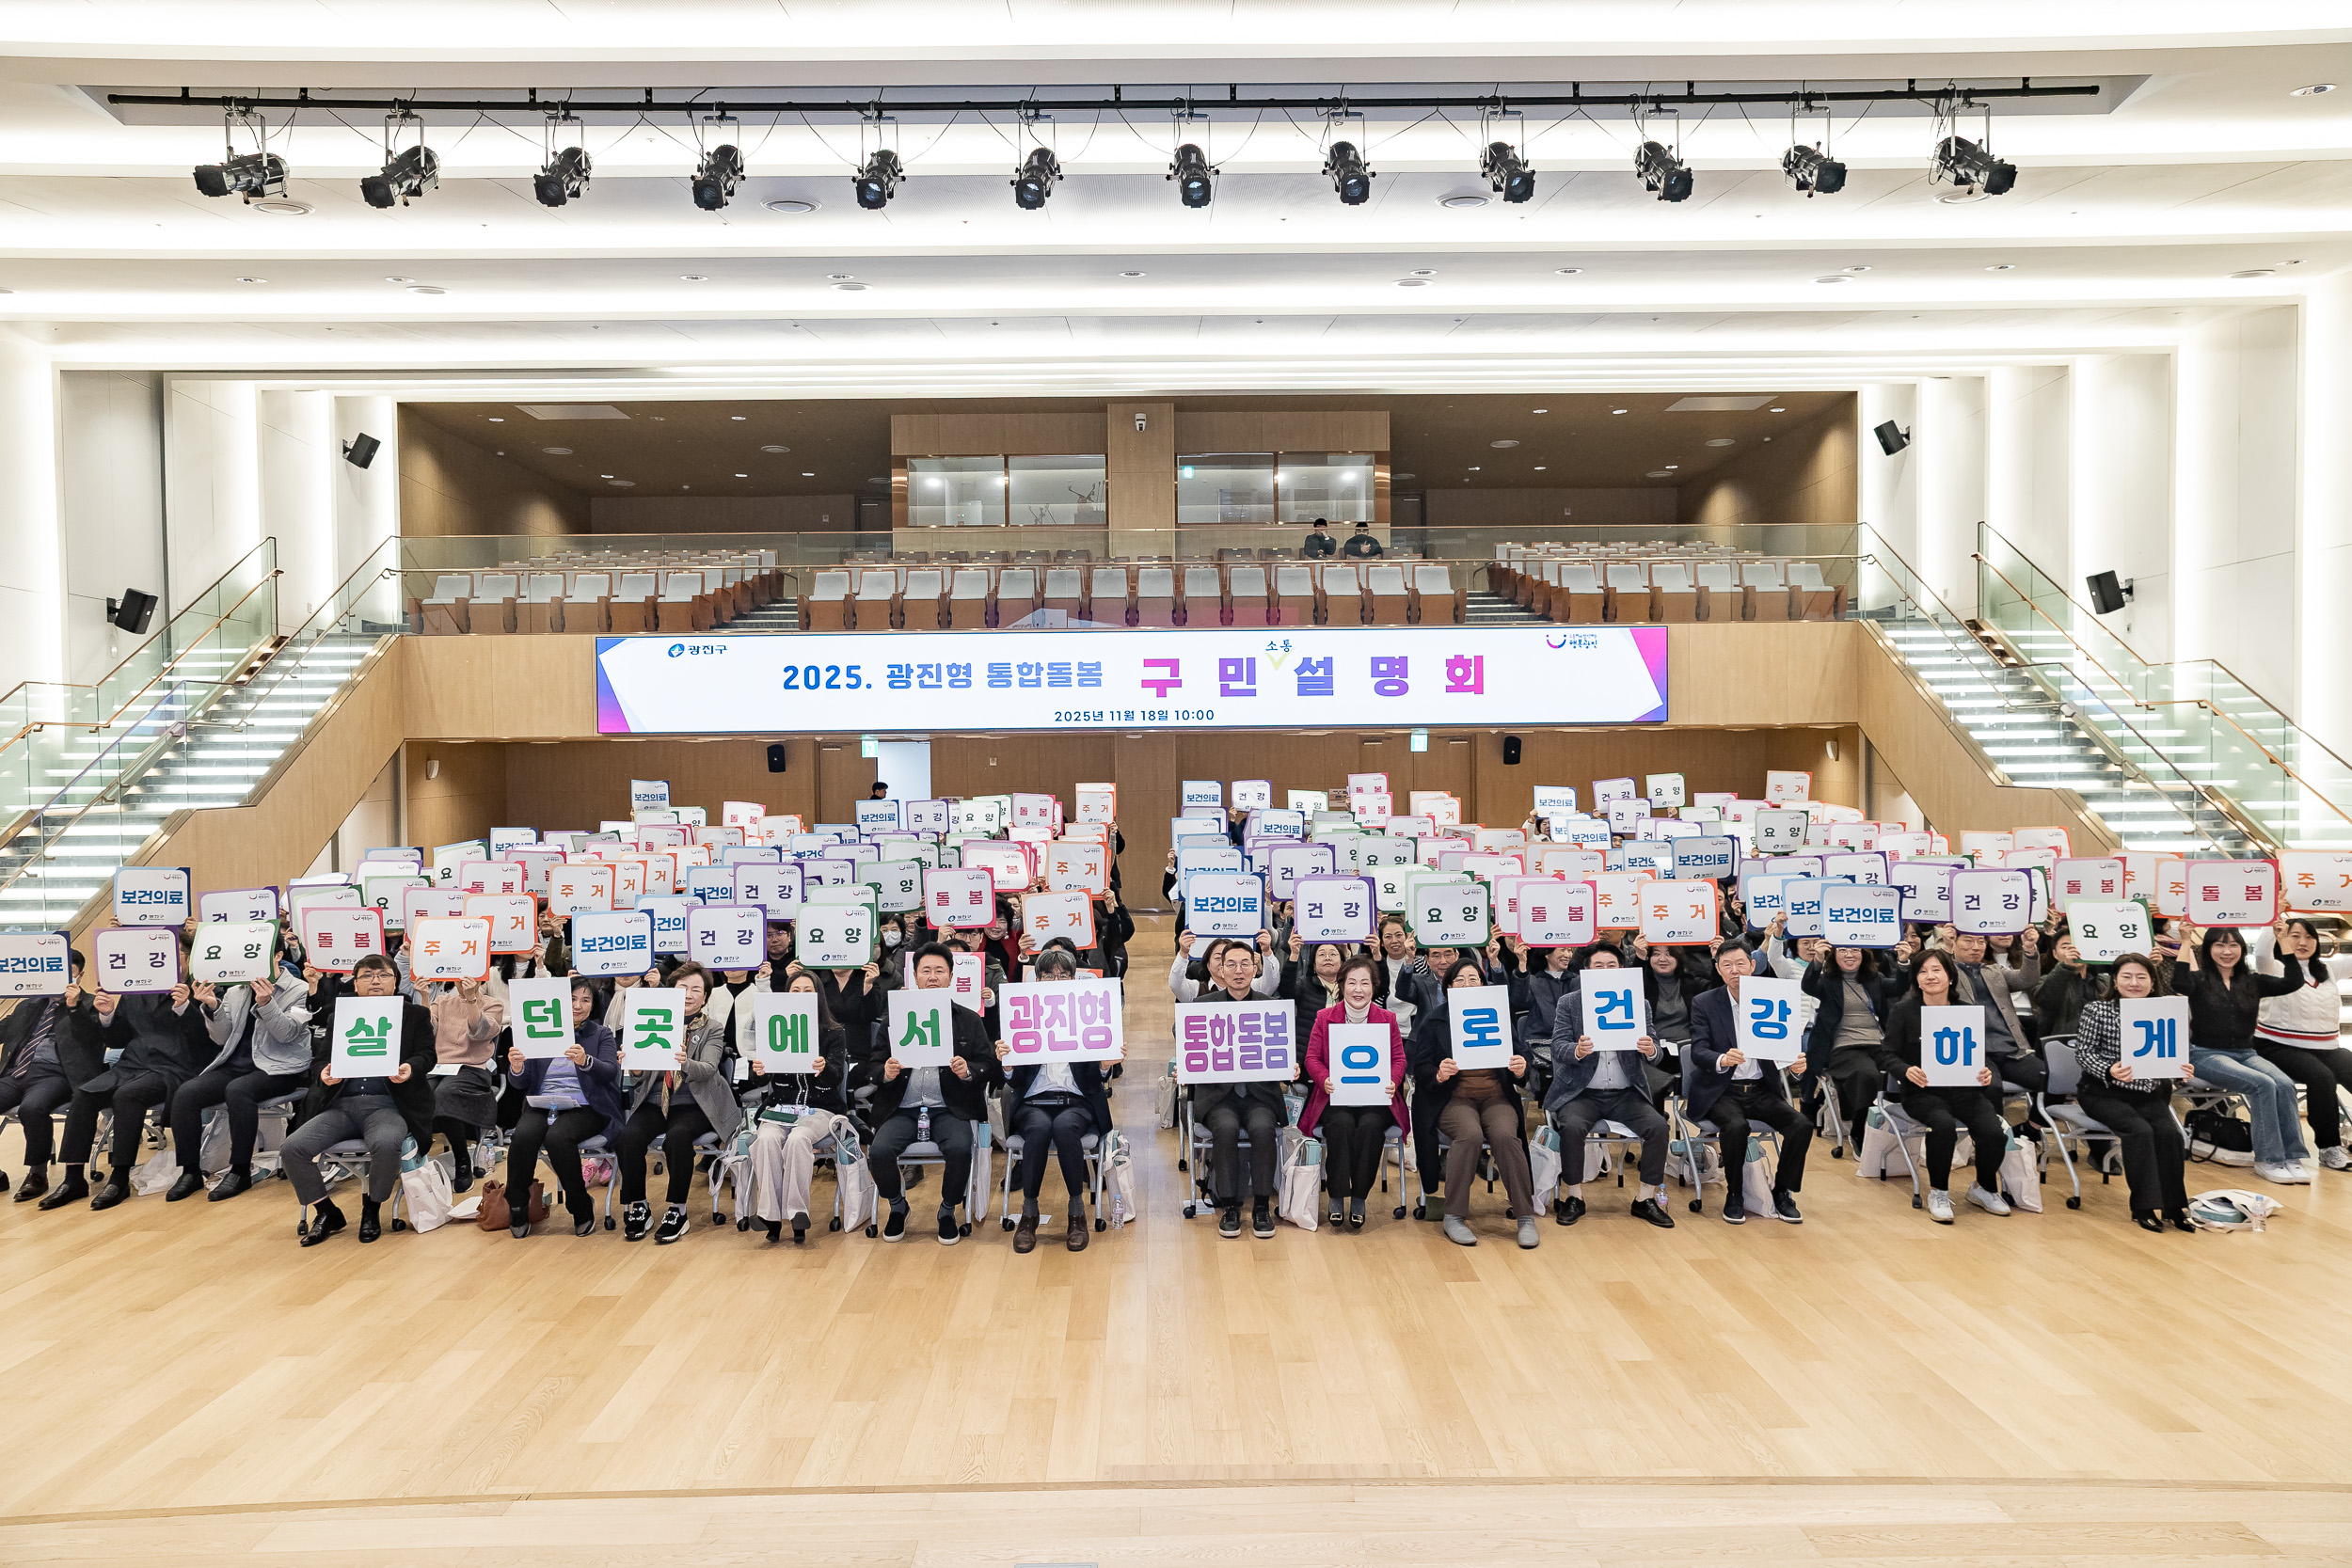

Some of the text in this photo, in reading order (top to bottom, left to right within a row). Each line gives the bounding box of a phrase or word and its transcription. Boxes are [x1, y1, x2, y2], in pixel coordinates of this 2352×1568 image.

[688, 645, 728, 655] 광진구
[1265, 640, 1294, 653] 소통
[783, 661, 1103, 690] 2025. 광진형 통합돌봄
[1055, 710, 1215, 721] 2025년 11월 18일 10:00
[635, 793, 666, 801] 보건의료
[862, 814, 896, 822] 보건의료
[1263, 824, 1300, 834] 보건의료
[1572, 833, 1609, 842] 보건의료
[1678, 854, 1728, 866] 보건의료
[121, 890, 183, 904] 보건의료
[1194, 896, 1258, 912] 보건의료
[1829, 908, 1894, 923] 보건의료
[580, 934, 646, 952] 보건의료
[523, 999, 564, 1037] 던
[1009, 990, 1113, 1054] 광진형
[1595, 990, 1635, 1030] 건
[1751, 999, 1791, 1039] 강
[346, 1017, 391, 1056] 살
[634, 1008, 674, 1049] 곳
[769, 1014, 808, 1053] 에
[899, 1008, 941, 1047] 서
[1184, 1012, 1288, 1071] 통합돌봄
[1463, 1008, 1502, 1048] 로
[2134, 1019, 2176, 1058] 게
[1933, 1027, 1977, 1066] 하
[1341, 1046, 1380, 1084] 으
